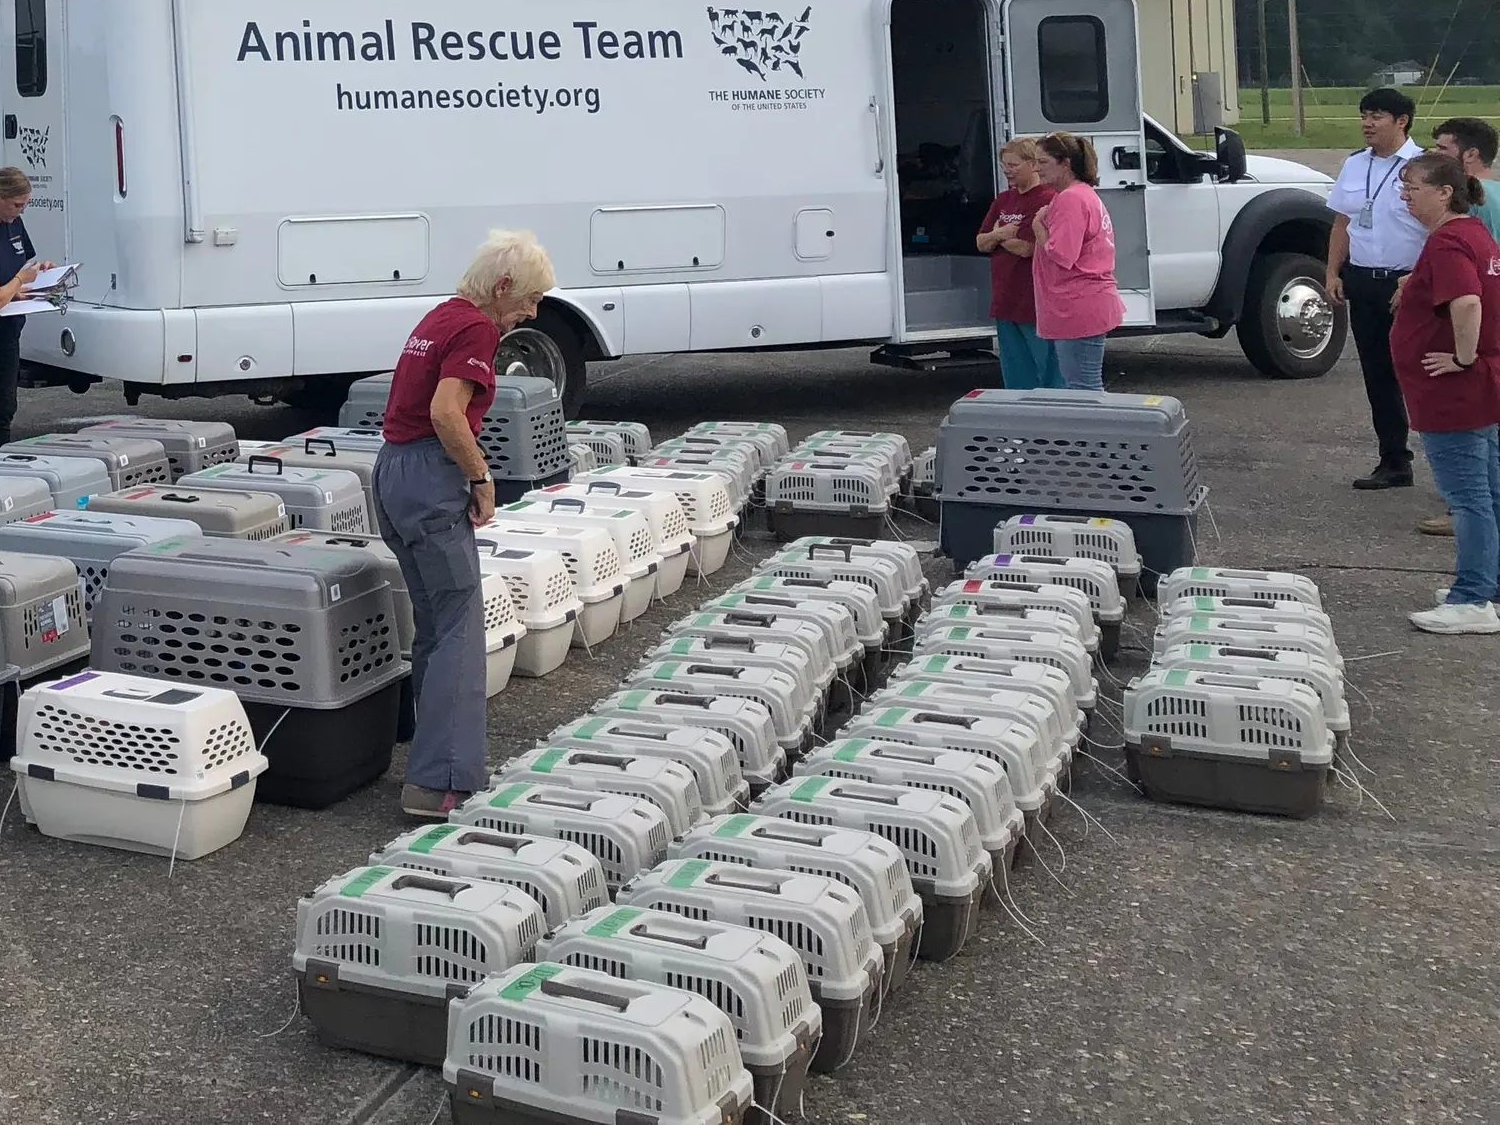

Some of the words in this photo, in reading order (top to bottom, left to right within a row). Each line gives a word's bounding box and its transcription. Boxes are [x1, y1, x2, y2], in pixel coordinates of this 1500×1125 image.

[236, 19, 396, 62] Animal
[411, 21, 562, 61] Rescue
[572, 21, 684, 60] Team
[336, 82, 601, 115] humanesociety.org
[708, 90, 729, 101] THE
[731, 89, 782, 101] HUMANE
[784, 88, 826, 100] SOCIETY
[731, 103, 741, 111] OF
[742, 103, 756, 111] THE
[757, 102, 782, 111] UNITED
[784, 102, 807, 110] STATES
